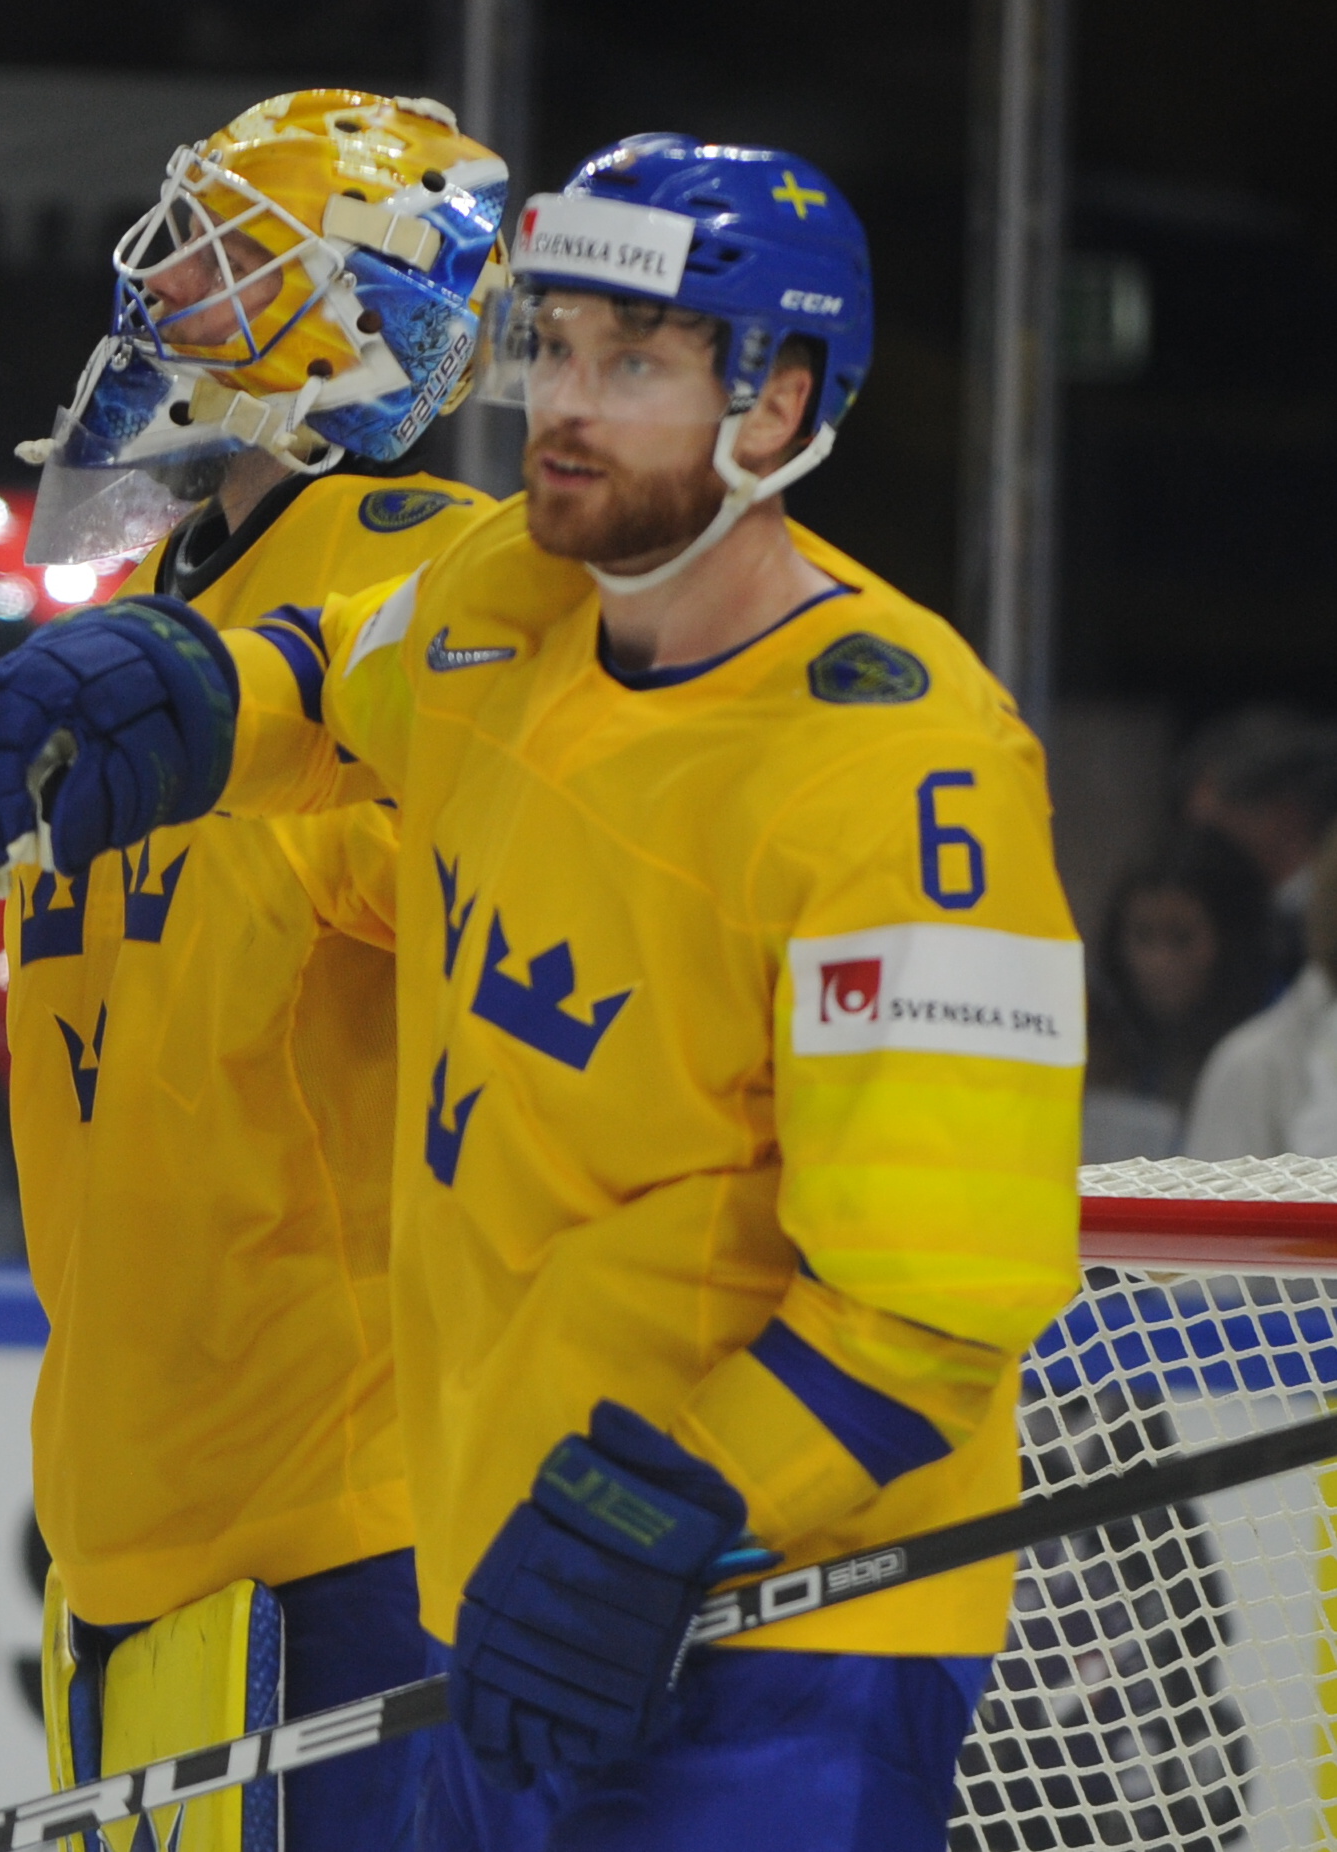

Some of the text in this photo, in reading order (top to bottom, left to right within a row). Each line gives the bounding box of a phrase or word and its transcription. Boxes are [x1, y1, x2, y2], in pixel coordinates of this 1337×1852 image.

[612, 243, 668, 276] SPEL
[780, 289, 844, 316] CCM
[917, 769, 987, 912] 6
[890, 999, 1061, 1038] SVENSKA SPEL
